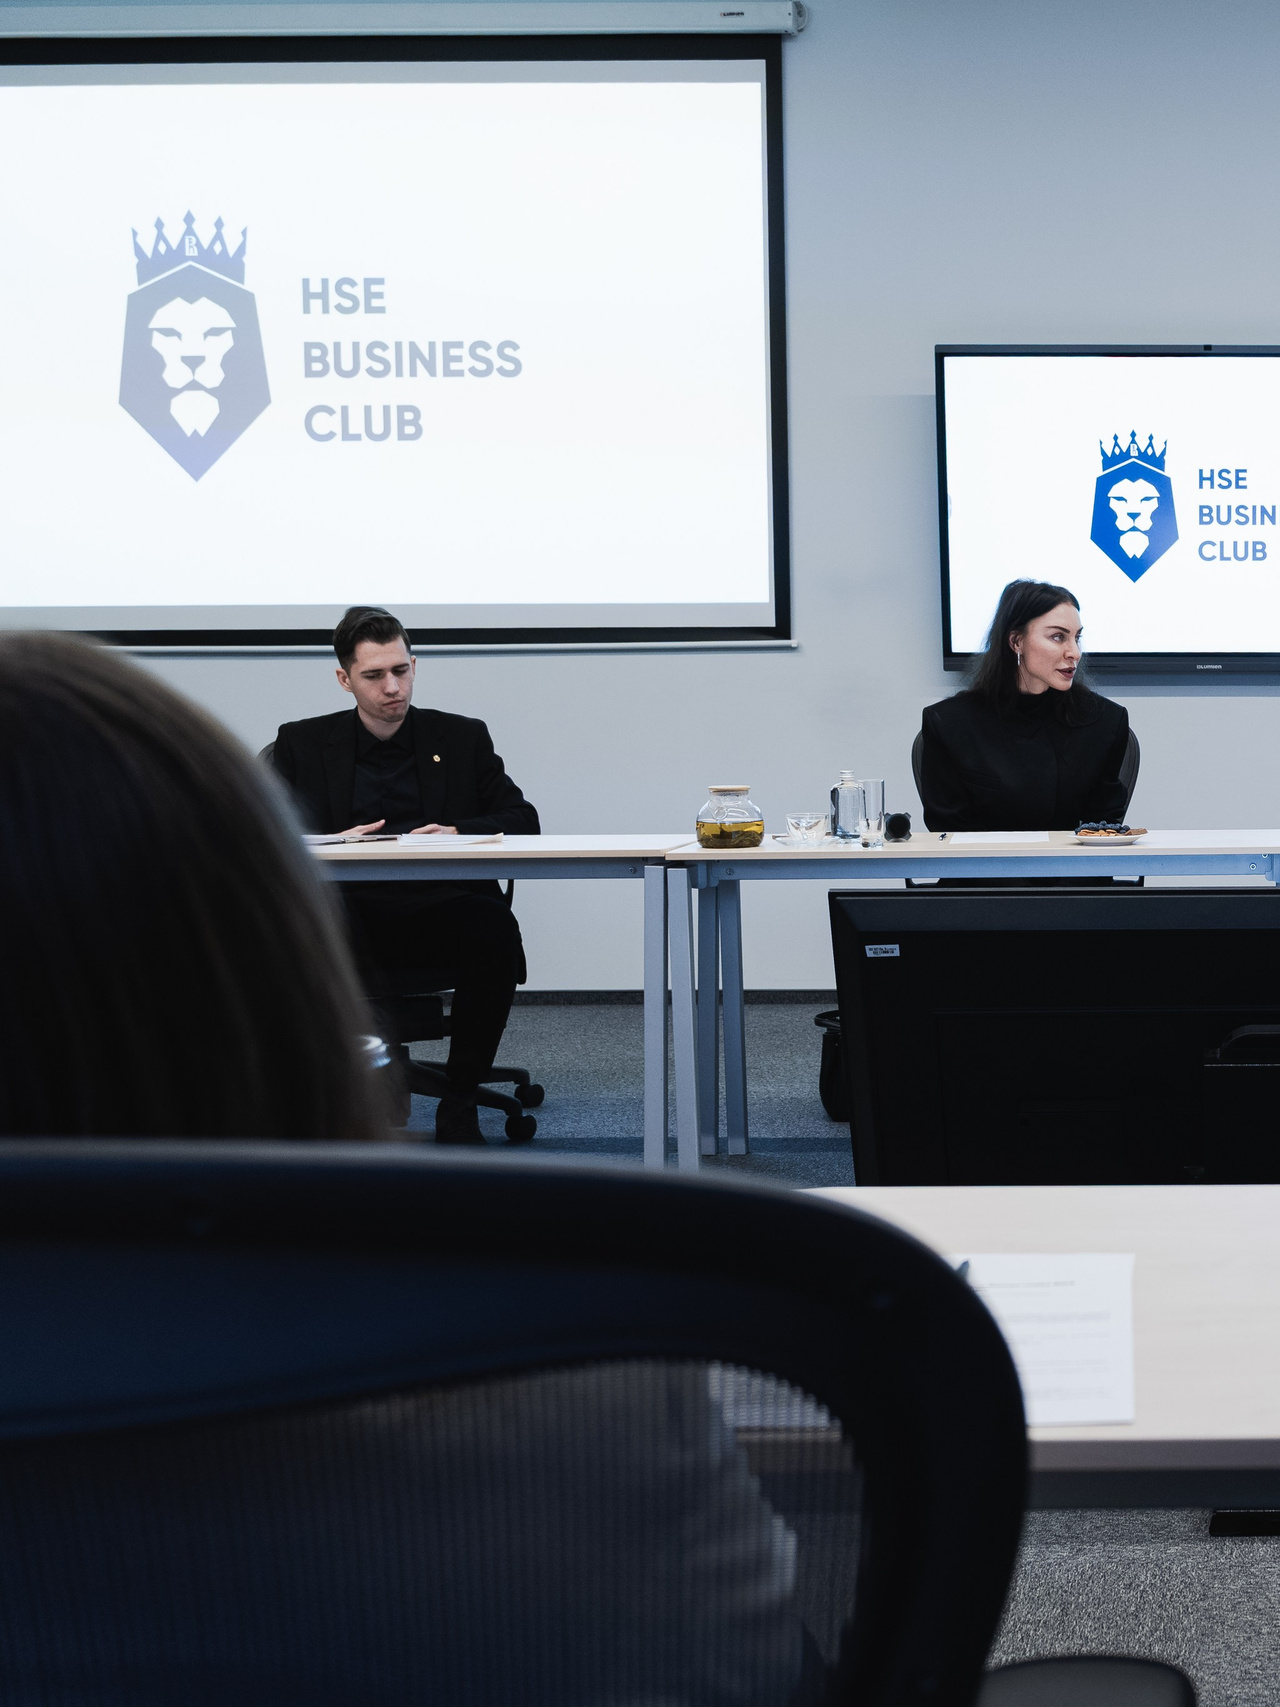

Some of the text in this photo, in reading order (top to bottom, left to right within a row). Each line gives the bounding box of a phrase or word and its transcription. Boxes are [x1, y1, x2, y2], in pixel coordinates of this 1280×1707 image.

[302, 277, 386, 315] HSE
[303, 340, 523, 379] BUSINESS
[304, 404, 424, 443] CLUB
[1198, 468, 1248, 490] HSE
[1198, 540, 1268, 562] CLUB
